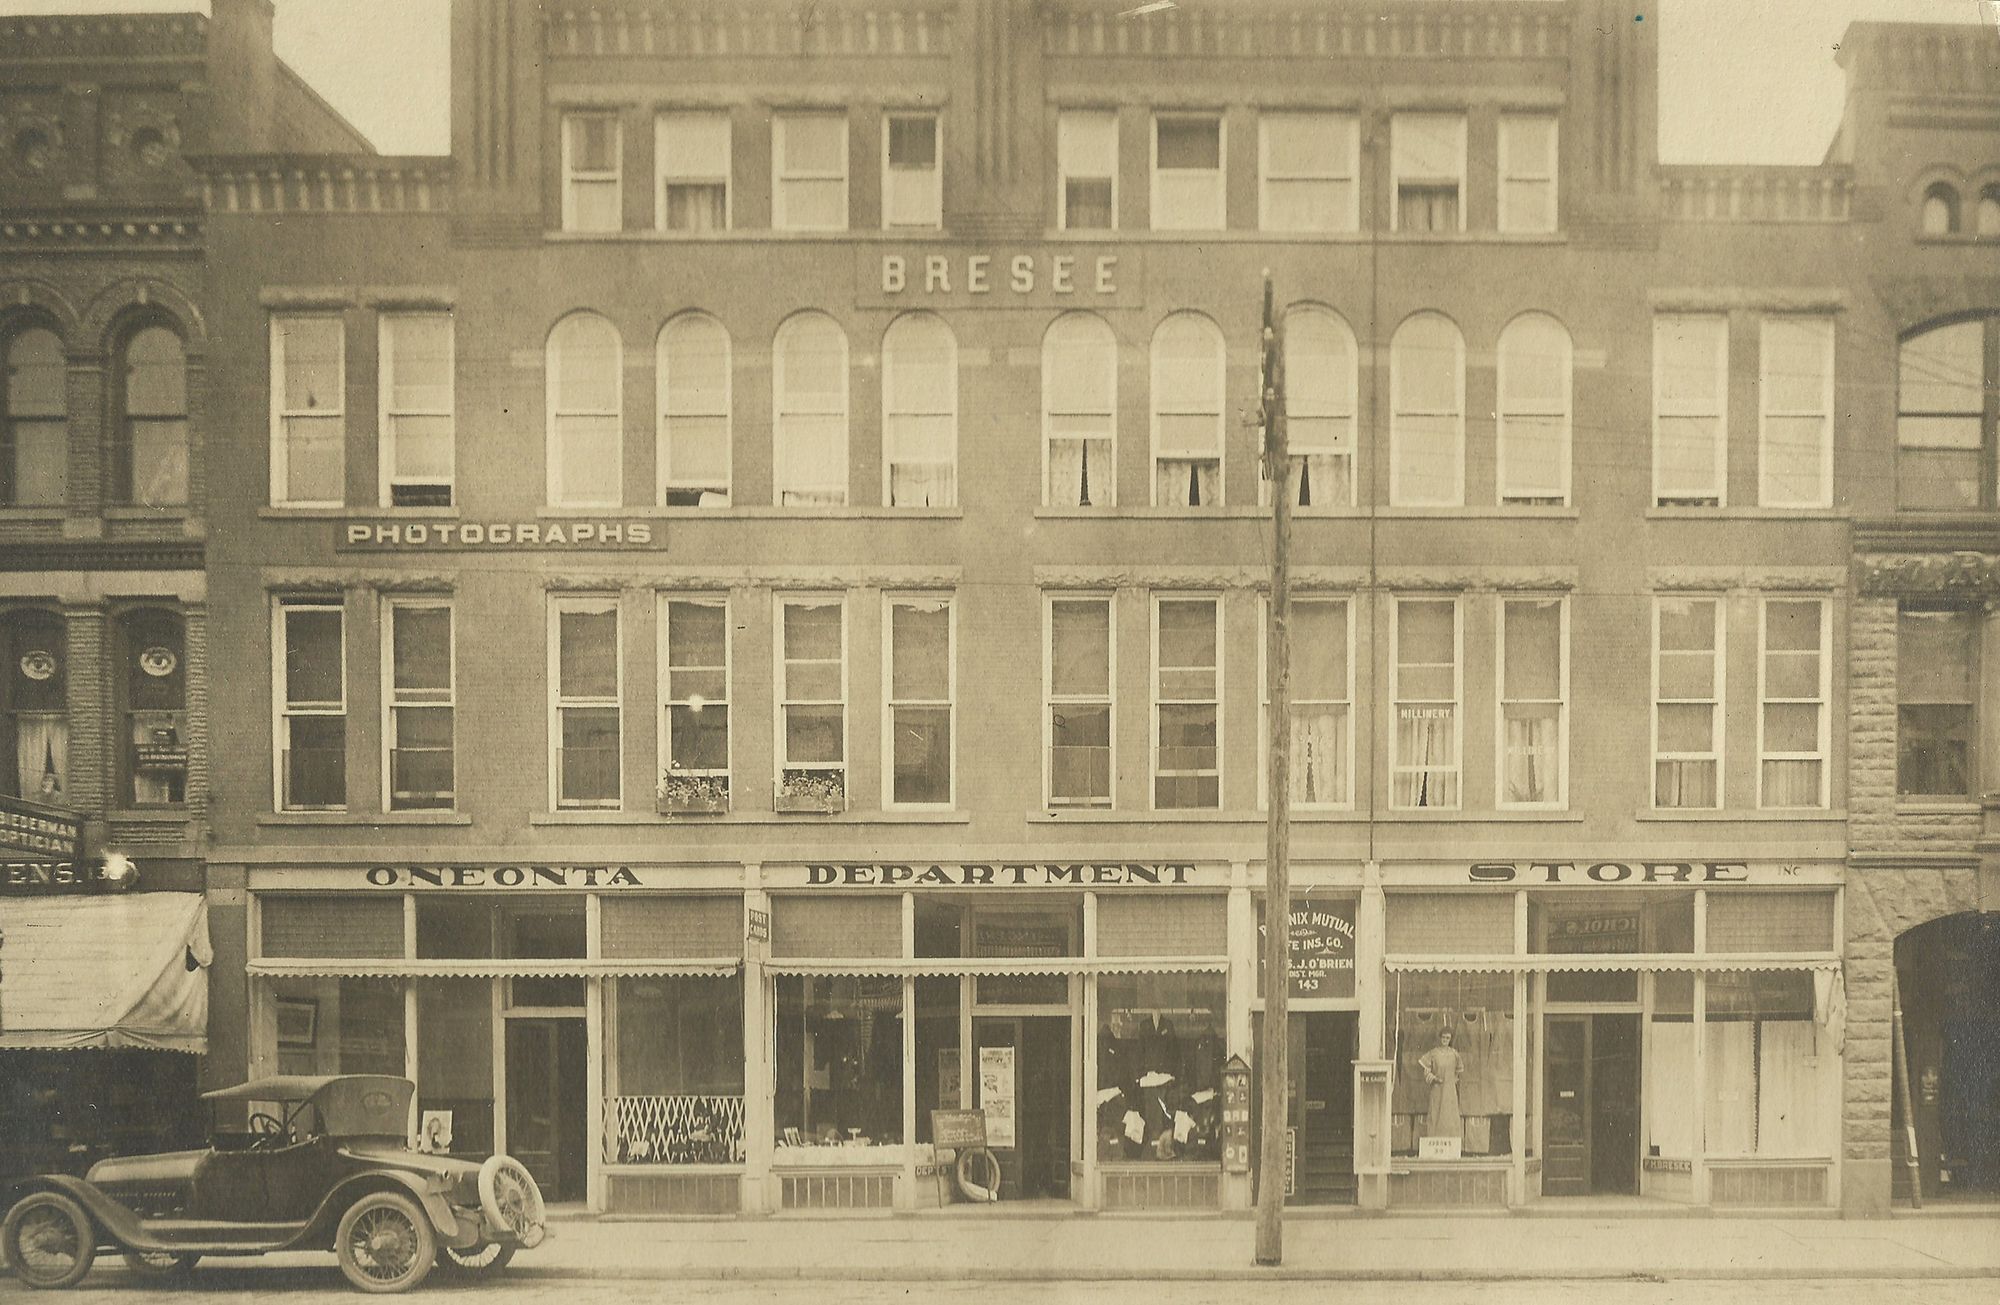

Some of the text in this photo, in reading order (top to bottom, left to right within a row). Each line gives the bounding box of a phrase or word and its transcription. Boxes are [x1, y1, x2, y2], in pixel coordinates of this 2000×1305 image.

[882, 255, 1118, 293] BRESEE
[347, 523, 651, 544] PHOTOGRAPHS
[366, 866, 643, 886] ONEONTA
[806, 864, 1197, 884] DEPARTMENT
[1468, 862, 1749, 882] STORE
[750, 911, 767, 924] POST
[1312, 912, 1355, 939] MUTUAL
[1303, 937, 1324, 950] INS.
